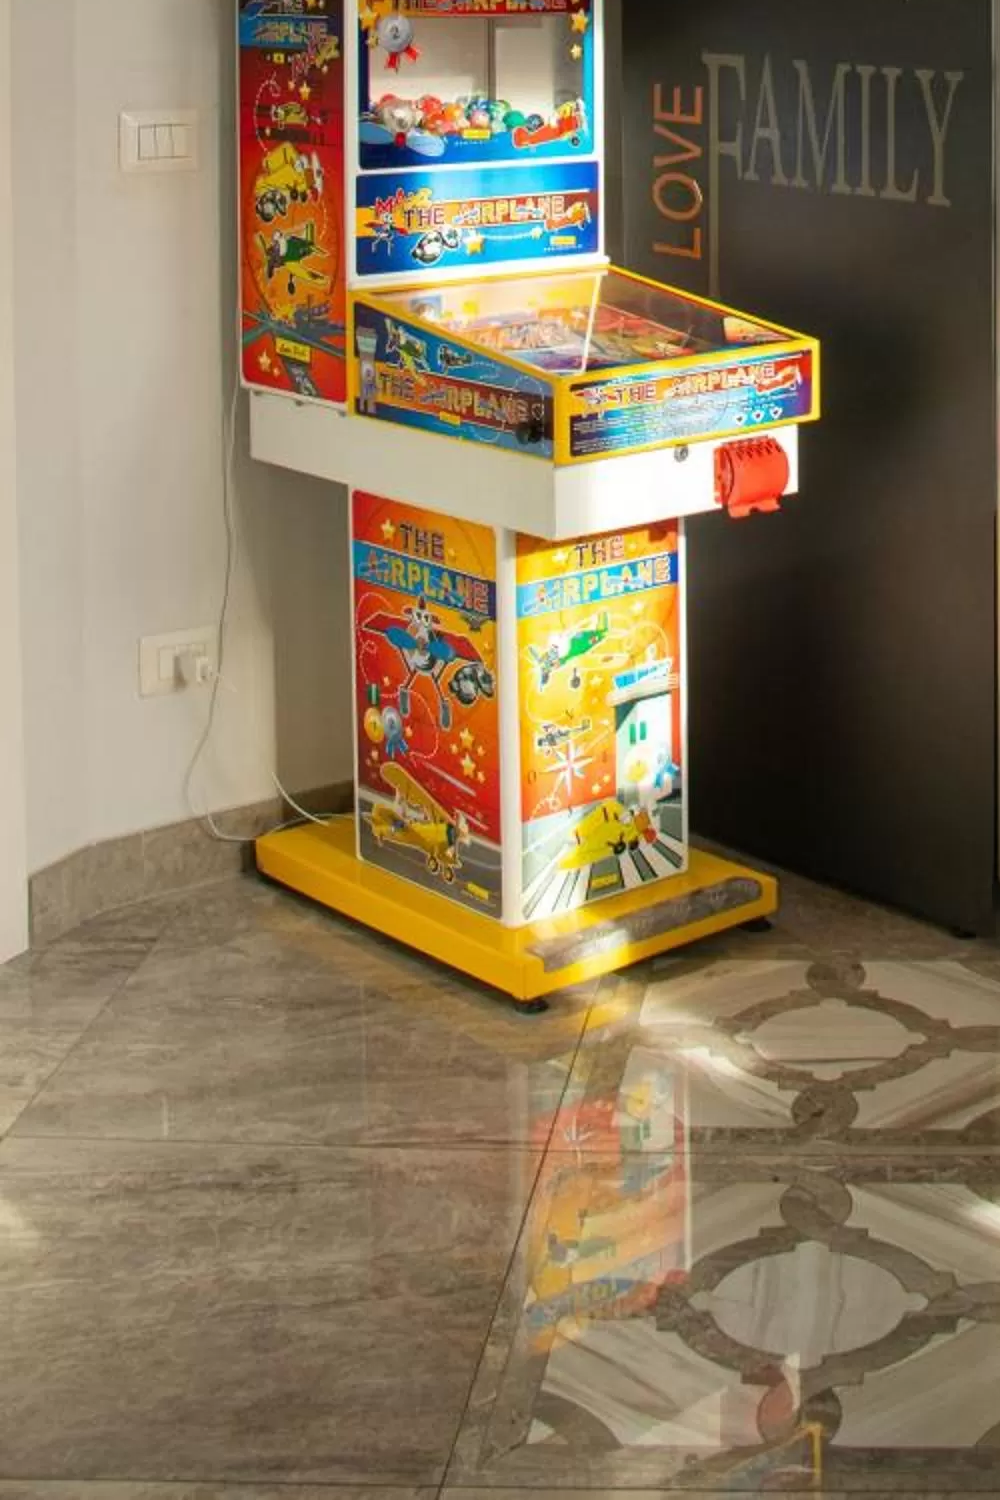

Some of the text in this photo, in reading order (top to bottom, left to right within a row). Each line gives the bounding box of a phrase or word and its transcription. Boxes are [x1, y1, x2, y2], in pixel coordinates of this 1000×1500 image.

[652, 83, 703, 259] LOVE
[702, 50, 964, 297] FAMILY
[404, 204, 445, 228] THE
[458, 195, 566, 225] AIRPLANE
[614, 382, 657, 404] THE
[400, 521, 445, 561] THE
[575, 534, 625, 568] THE
[366, 549, 489, 614] AIRPLANE
[535, 555, 672, 609] AIRPLANE
